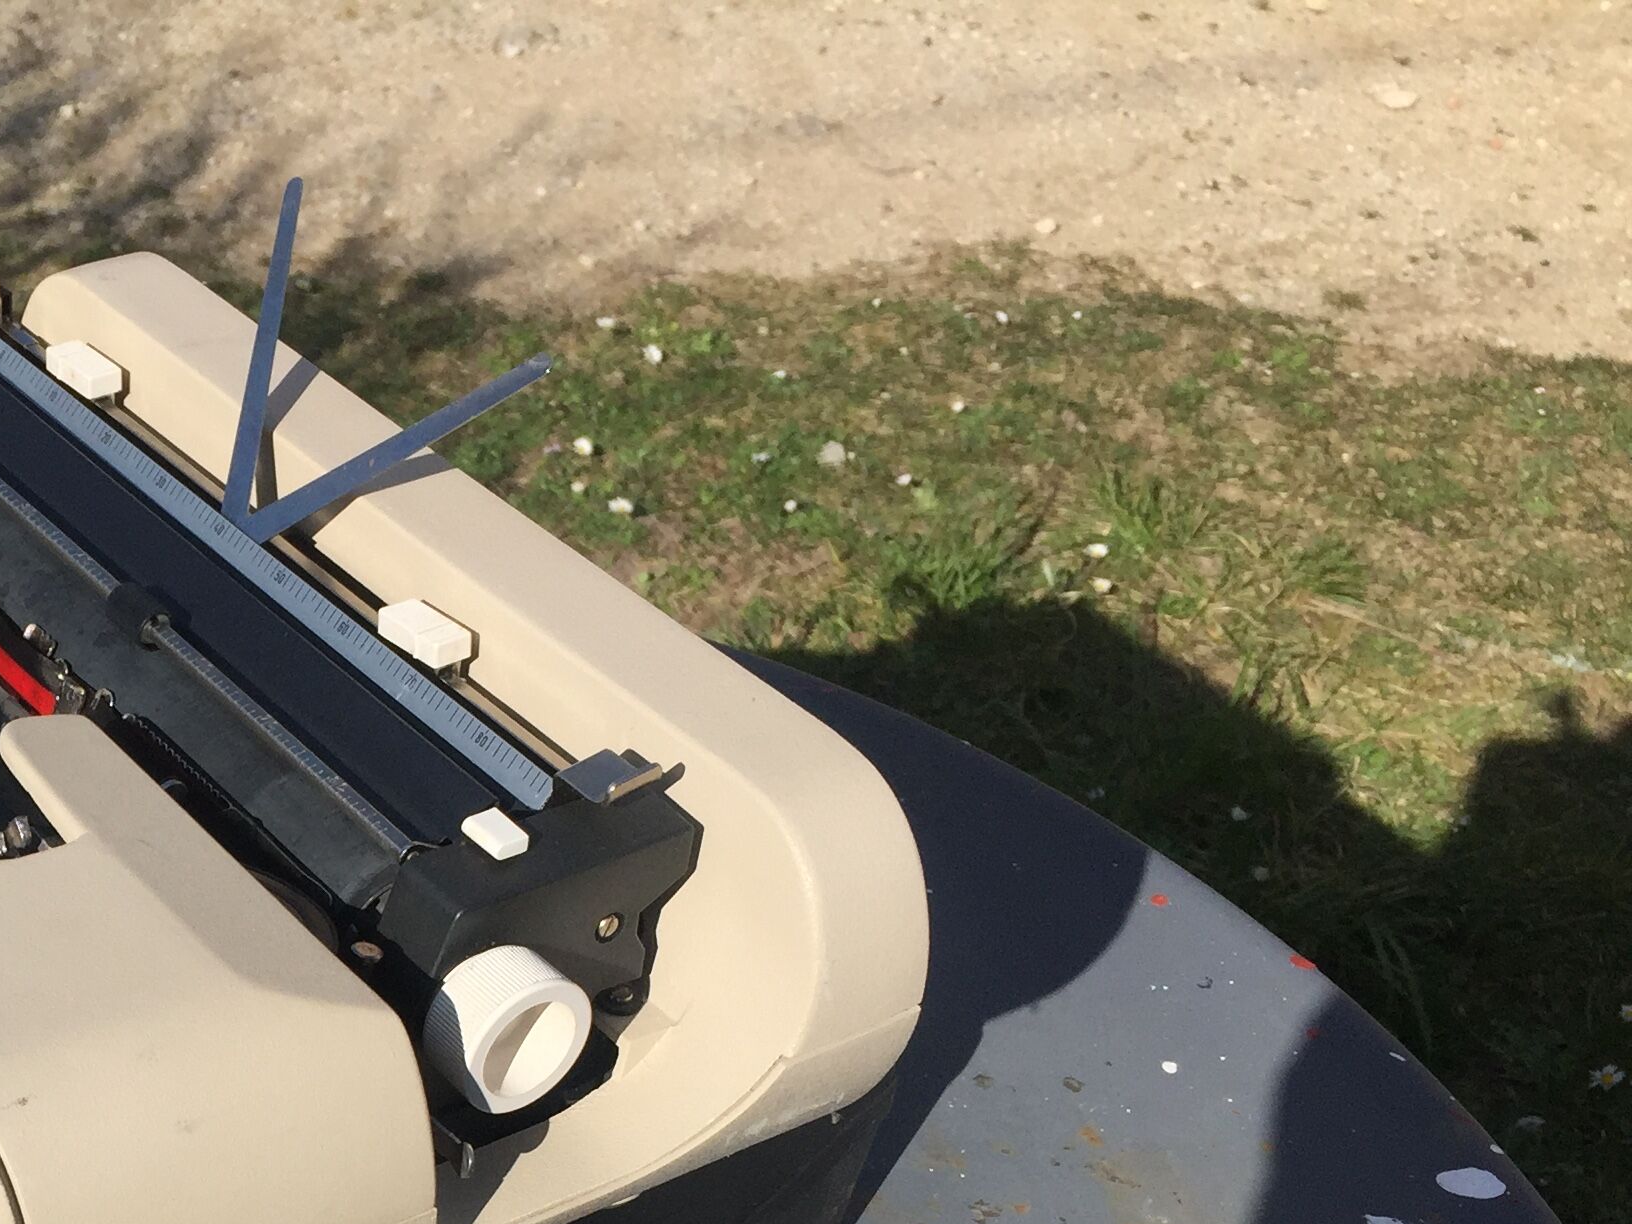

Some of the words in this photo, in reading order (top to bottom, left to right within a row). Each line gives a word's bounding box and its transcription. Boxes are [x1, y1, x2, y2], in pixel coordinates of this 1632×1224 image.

[273, 570, 286, 585] 50
[336, 622, 350, 636] 60
[474, 733, 489, 747] 80
